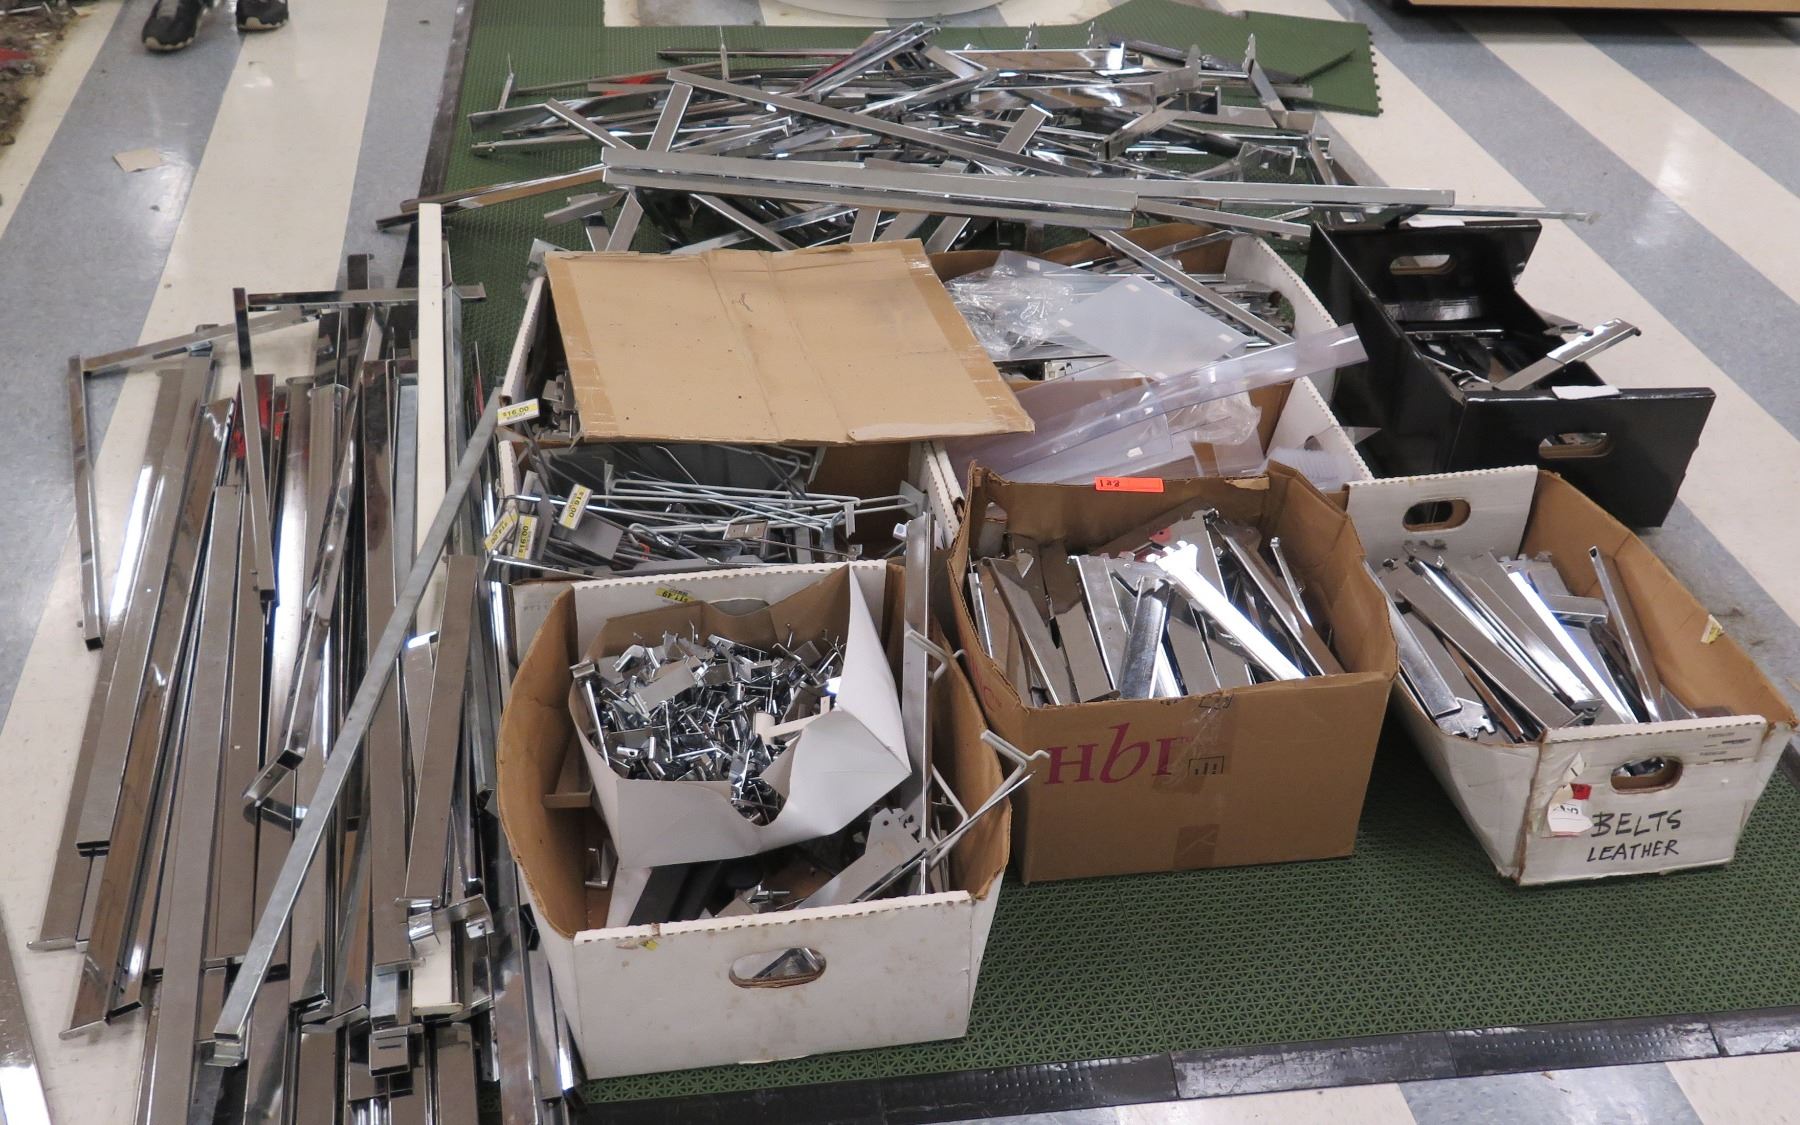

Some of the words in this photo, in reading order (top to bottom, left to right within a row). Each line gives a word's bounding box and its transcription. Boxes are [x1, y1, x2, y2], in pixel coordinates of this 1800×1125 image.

[503, 406, 529, 417] $16.00
[519, 525, 529, 553] $16.00
[1591, 809, 1683, 838] BELTS
[1586, 839, 1680, 863] LEATHER
